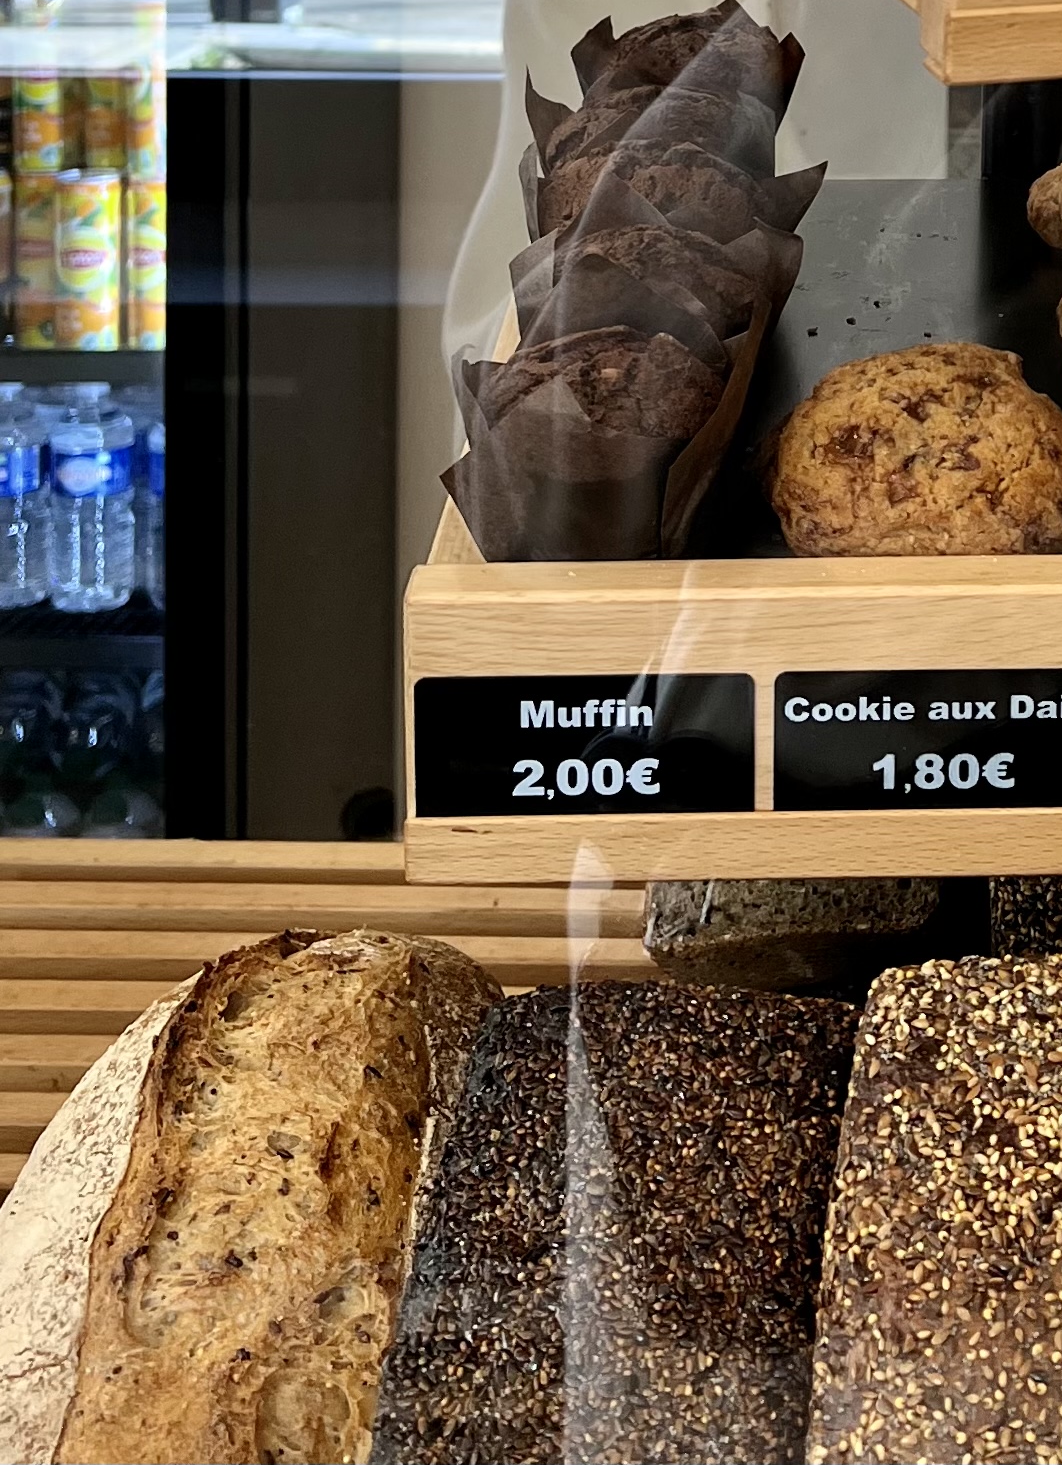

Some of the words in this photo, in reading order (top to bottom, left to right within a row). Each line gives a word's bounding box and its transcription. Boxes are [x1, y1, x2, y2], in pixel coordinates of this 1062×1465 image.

[519, 699, 655, 730] Muffin
[784, 695, 916, 723] Cookie
[927, 701, 997, 721] aux
[512, 757, 661, 801] 2,00€
[872, 753, 1016, 794] 1,80€
